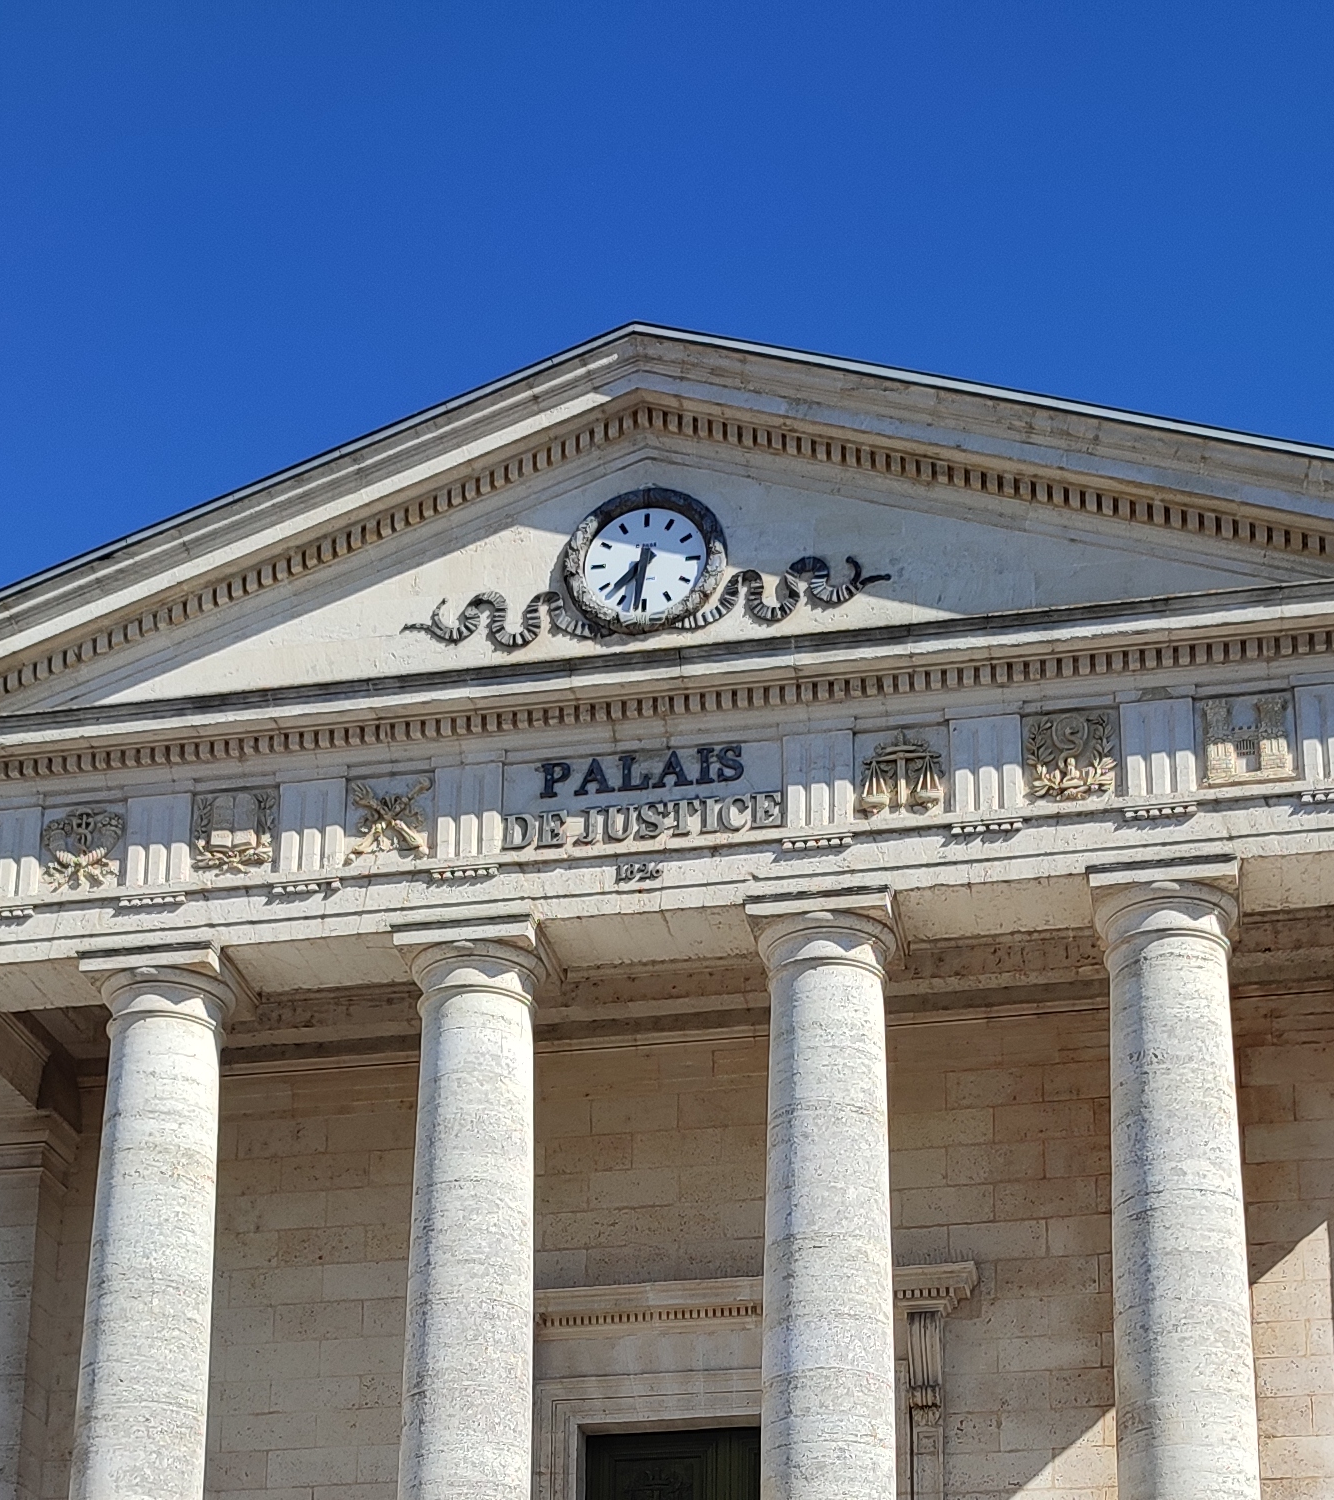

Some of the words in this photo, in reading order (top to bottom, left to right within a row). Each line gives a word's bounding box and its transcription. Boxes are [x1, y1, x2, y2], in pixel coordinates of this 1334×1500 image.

[539, 744, 745, 800] PALAIS
[503, 809, 568, 850] DE
[572, 790, 784, 847] JUSTICE
[616, 861, 664, 882] 1826
